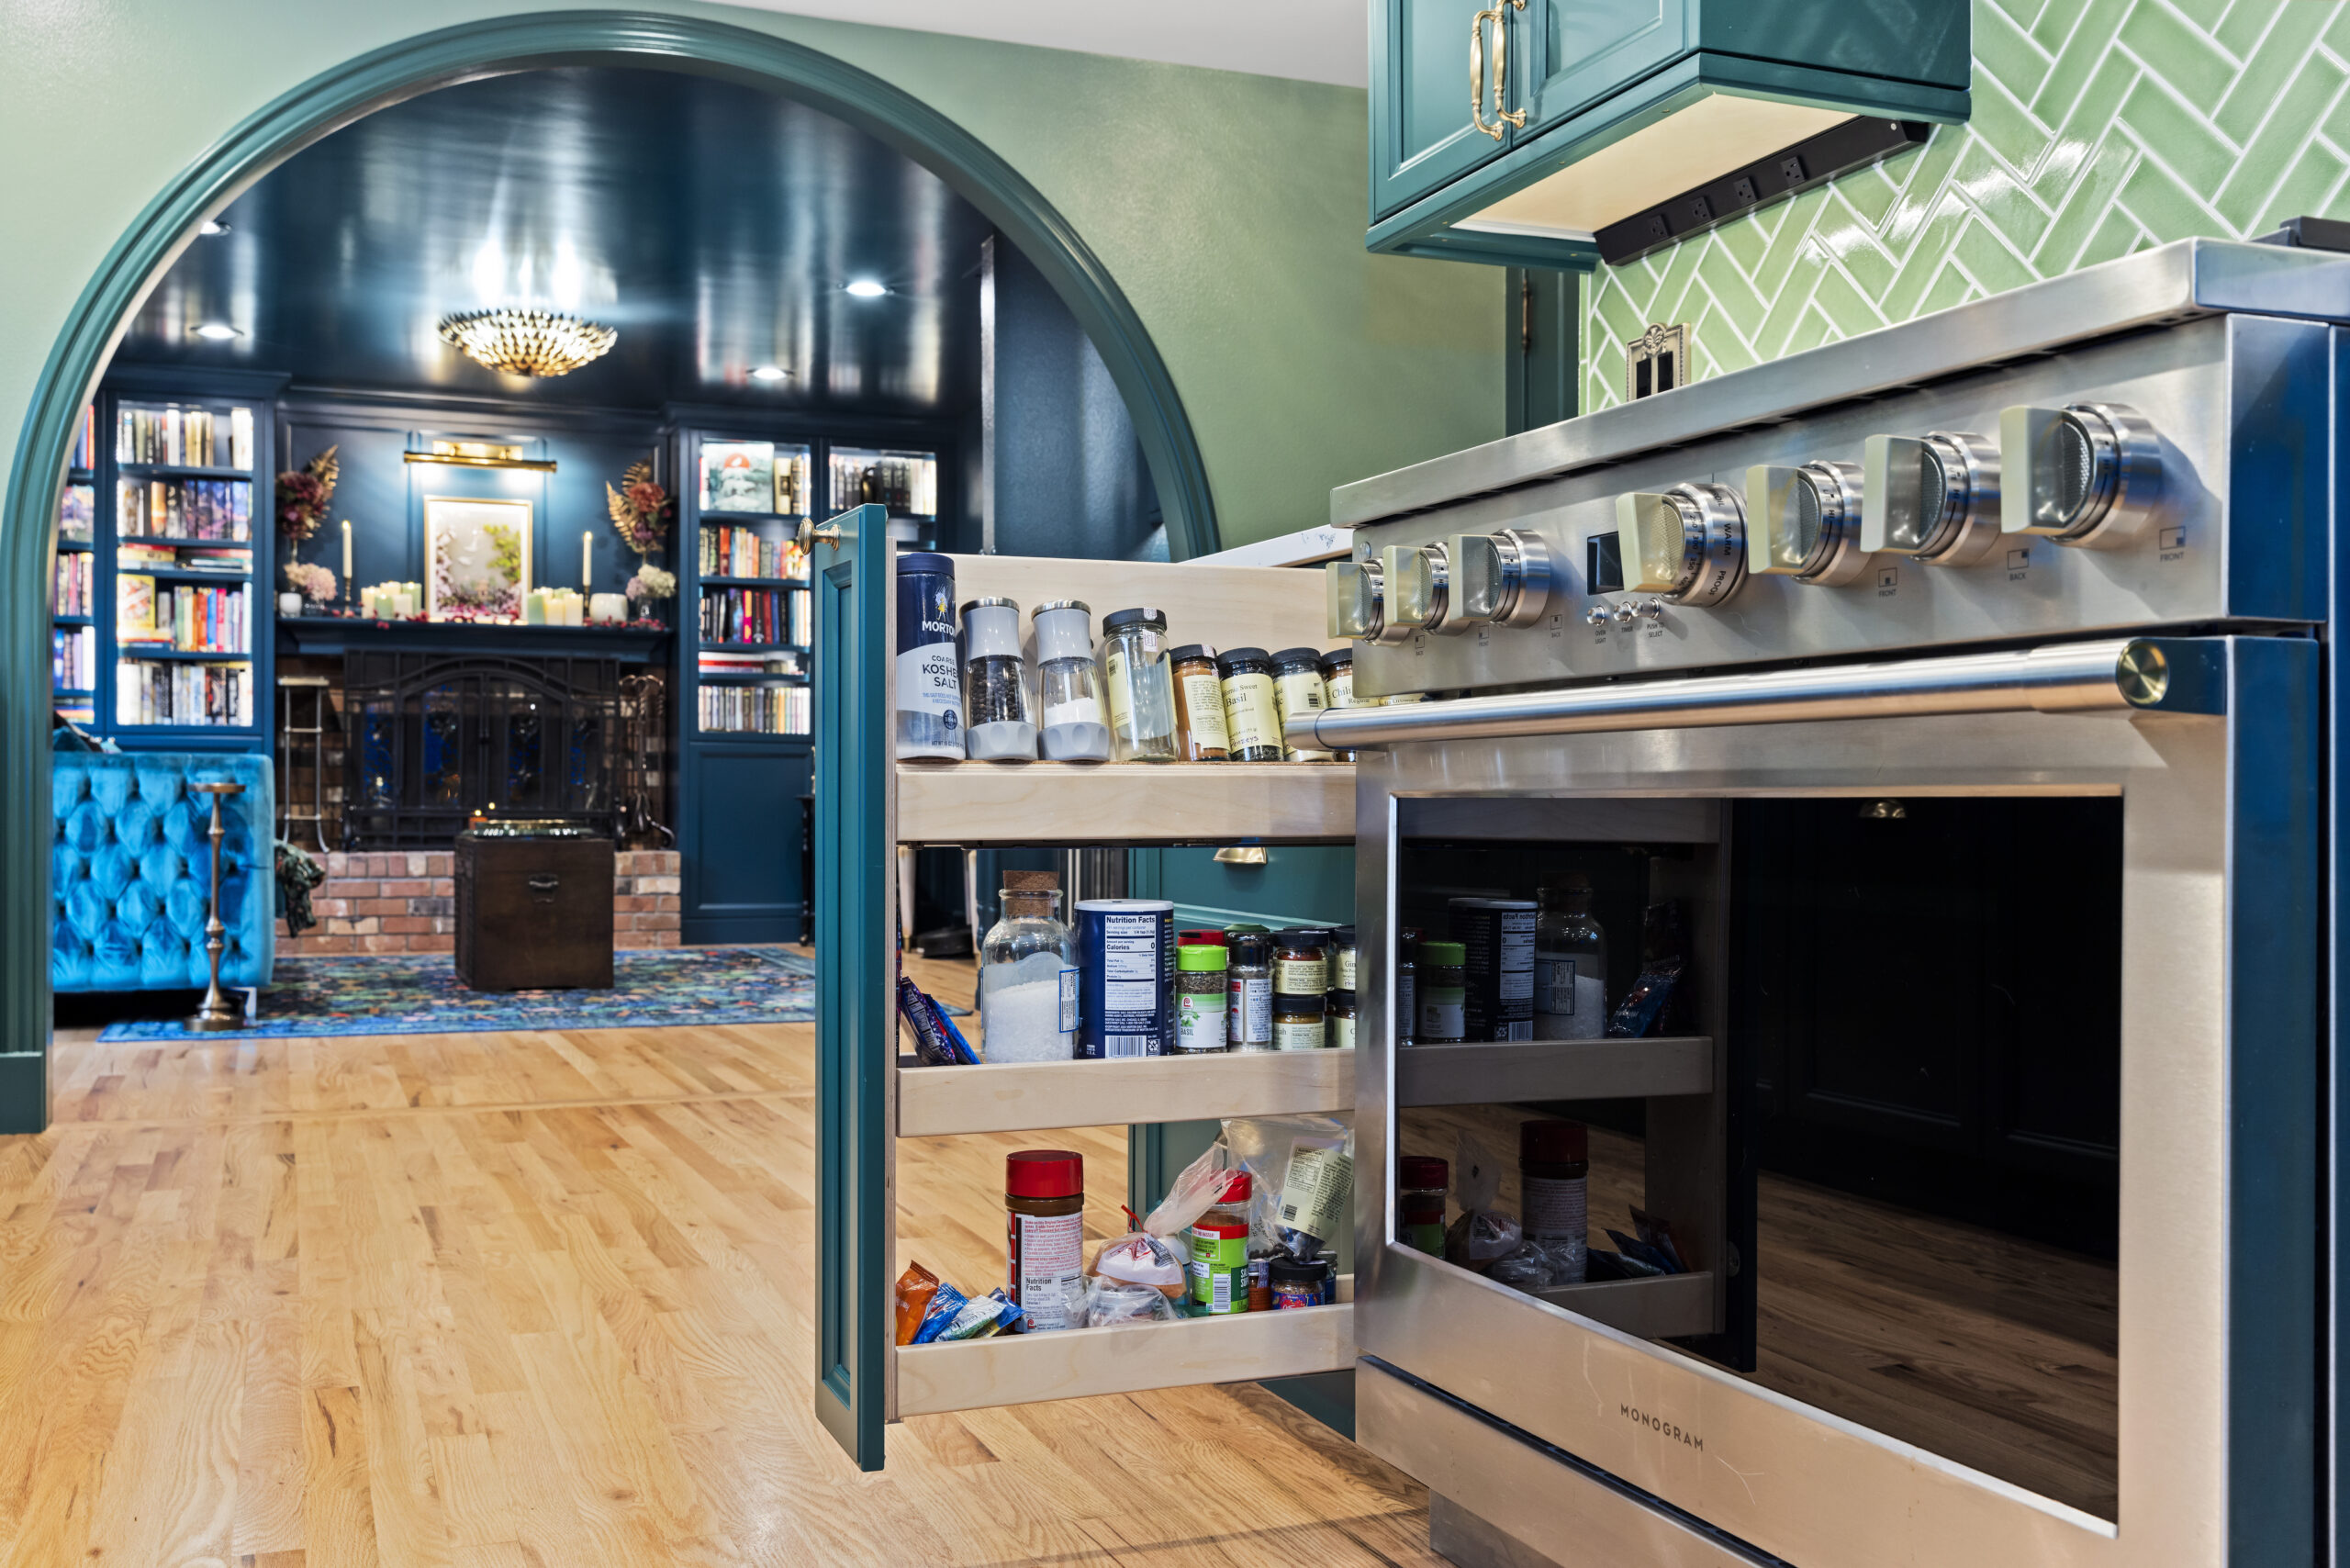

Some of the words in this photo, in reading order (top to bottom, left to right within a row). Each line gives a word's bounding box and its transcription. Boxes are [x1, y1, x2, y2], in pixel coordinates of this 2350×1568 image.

[1829, 510, 1835, 519] HI
[1723, 523, 1733, 556] WARM
[1687, 556, 1696, 571] 350
[2160, 552, 2184, 563] FRONT
[1708, 570, 1727, 596] PROOF
[2009, 572, 2027, 581] BACK
[1878, 588, 1897, 597] FRONT
[922, 621, 956, 636] MORTO
[923, 664, 958, 678] KOSHE
[934, 677, 957, 689] SALT
[1332, 686, 1352, 699] Chili
[1225, 692, 1247, 708] Basil
[1230, 735, 1259, 749] Penzeys
[1620, 1403, 1704, 1451] MONOGRAM
